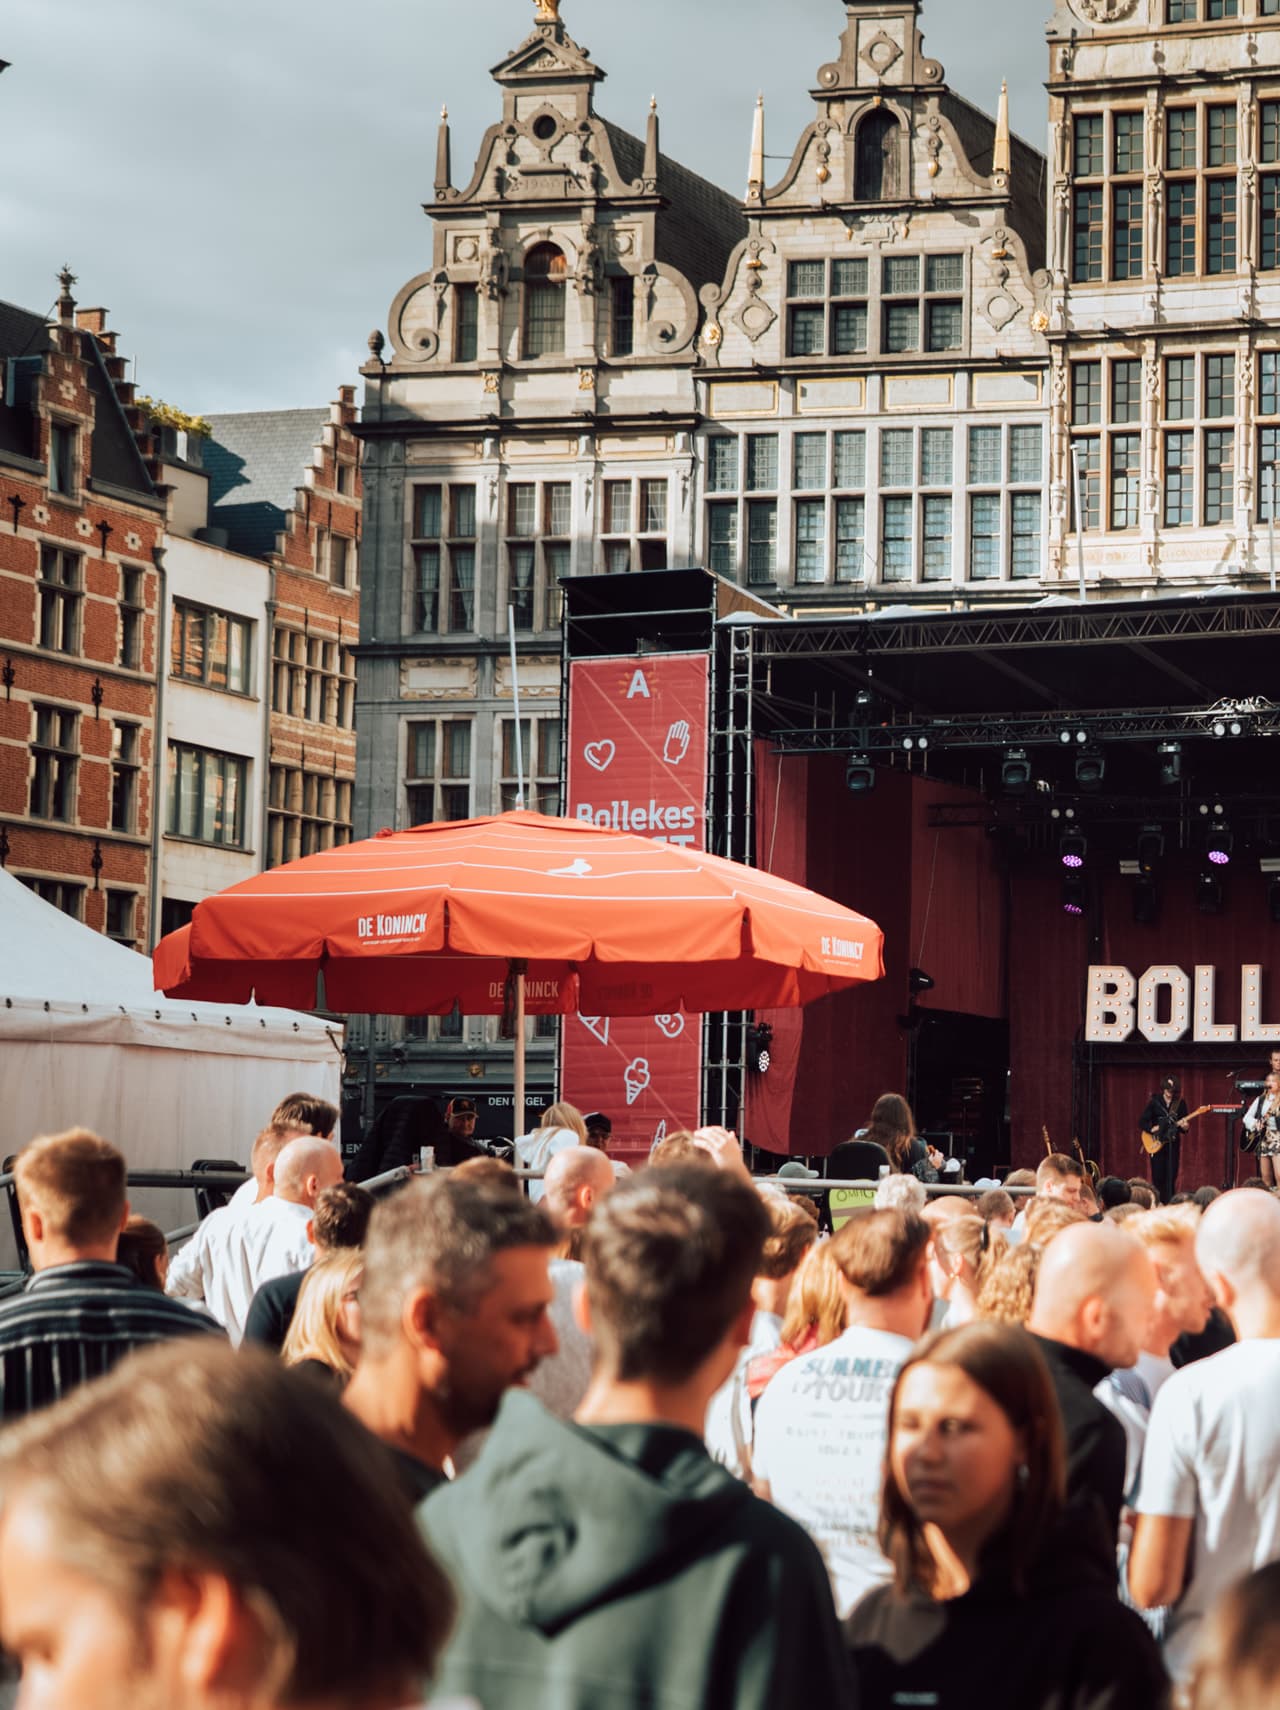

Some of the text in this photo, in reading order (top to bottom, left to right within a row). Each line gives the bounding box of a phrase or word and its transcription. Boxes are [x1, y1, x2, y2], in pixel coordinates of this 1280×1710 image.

[626, 669, 650, 699] A
[358, 913, 427, 937] DE KONINCK
[489, 982, 504, 998] DE
[488, 1097, 546, 1106] DEN GEL
